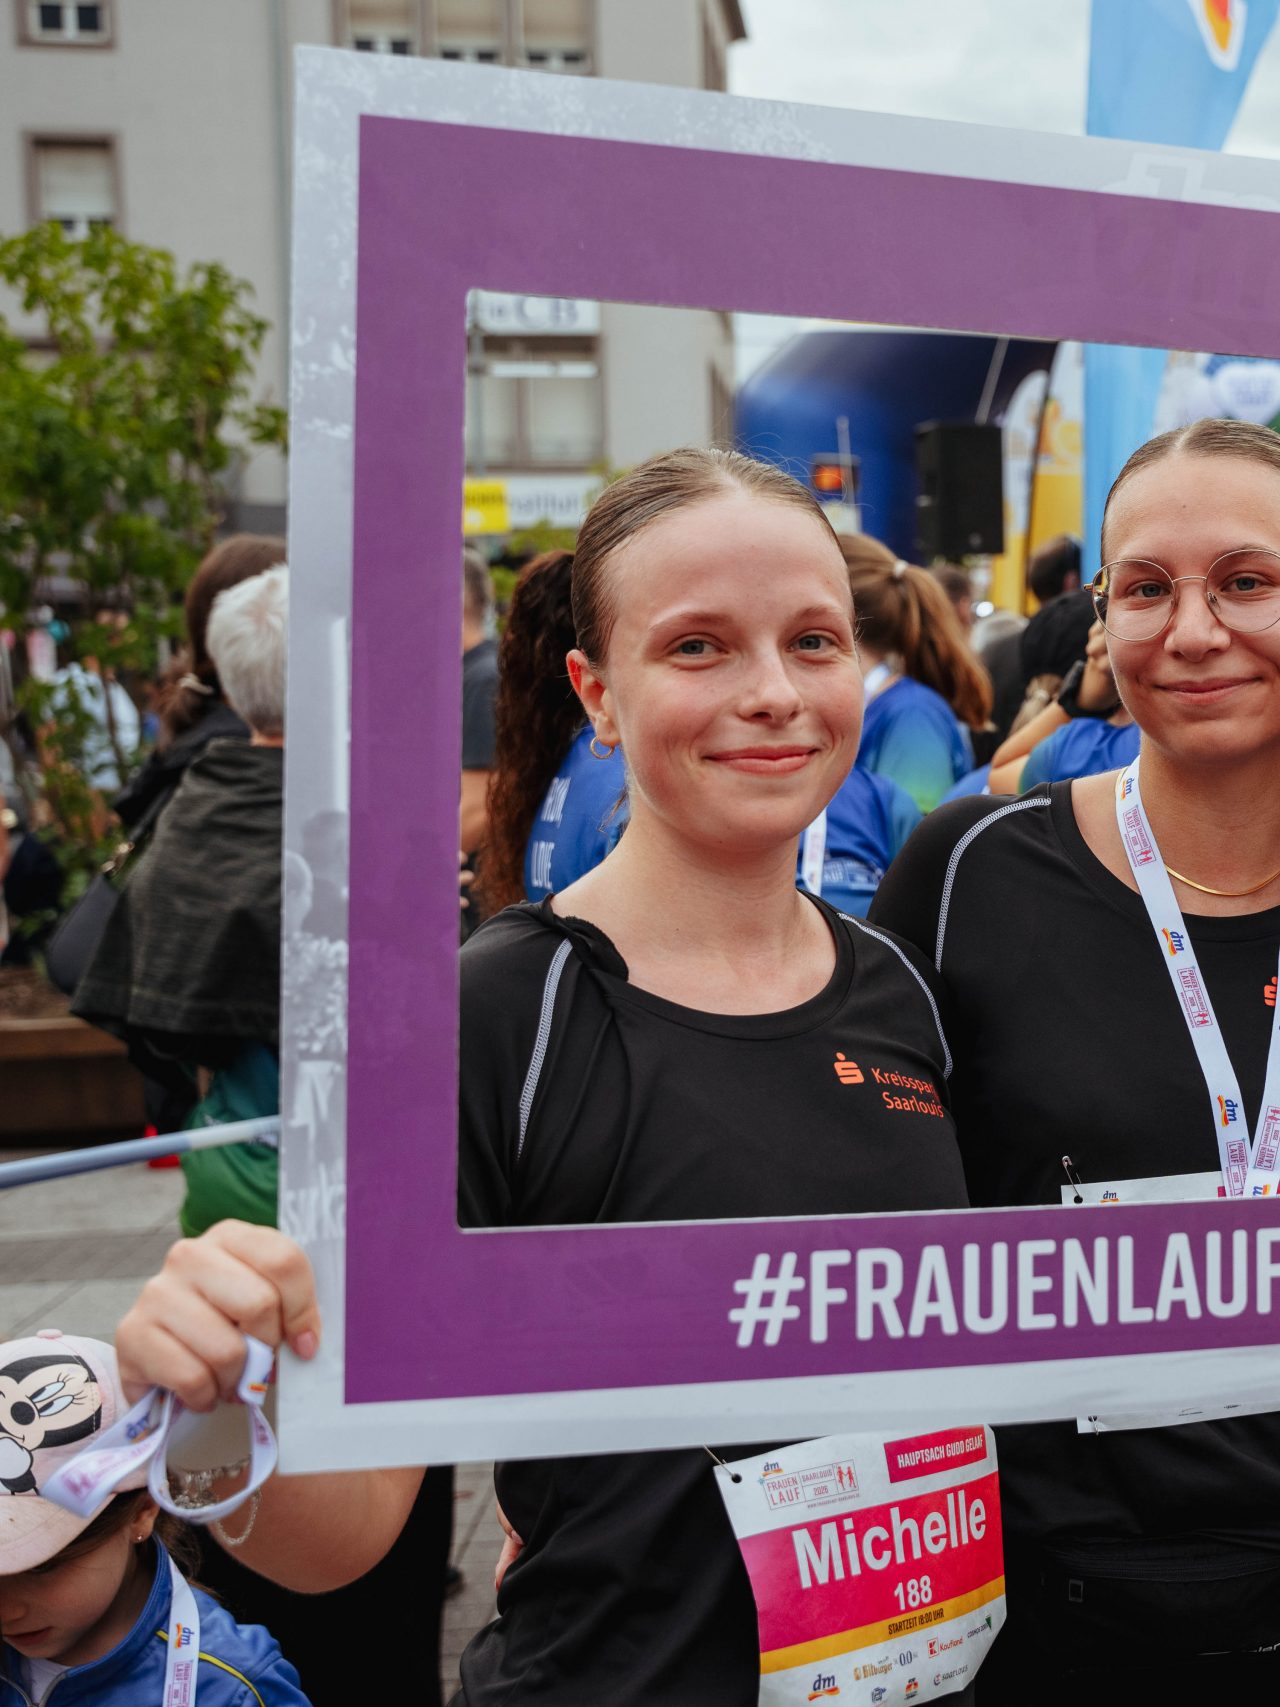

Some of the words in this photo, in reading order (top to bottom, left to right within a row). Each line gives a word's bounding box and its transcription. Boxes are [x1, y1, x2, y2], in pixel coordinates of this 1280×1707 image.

[1170, 931, 1184, 951] dm
[1180, 970, 1193, 989] LAUF
[871, 1067, 939, 1100] Kreisspar
[882, 1092, 944, 1118] Saarlouis
[1225, 1099, 1239, 1121] dm
[1229, 1143, 1239, 1164] LAUF
[1264, 1148, 1276, 1169] LAUF
[1103, 1190, 1118, 1200] dm
[897, 1445, 945, 1469] HAUPTSACH
[946, 1439, 964, 1457] GUDD
[965, 1434, 983, 1452] GELAAF
[763, 1461, 780, 1472] dm
[801, 1469, 833, 1482] SAARLOUIS
[767, 1477, 798, 1492] FRAUEN
[770, 1487, 801, 1506] LAUF
[791, 1489, 987, 1590] Michelle
[894, 1575, 933, 1611] 188
[888, 1617, 918, 1636] STARTZEIT
[918, 1612, 932, 1626] 18:00
[933, 1607, 944, 1622] UHR
[182, 1627, 194, 1645] dm
[812, 1673, 837, 1693] dm
